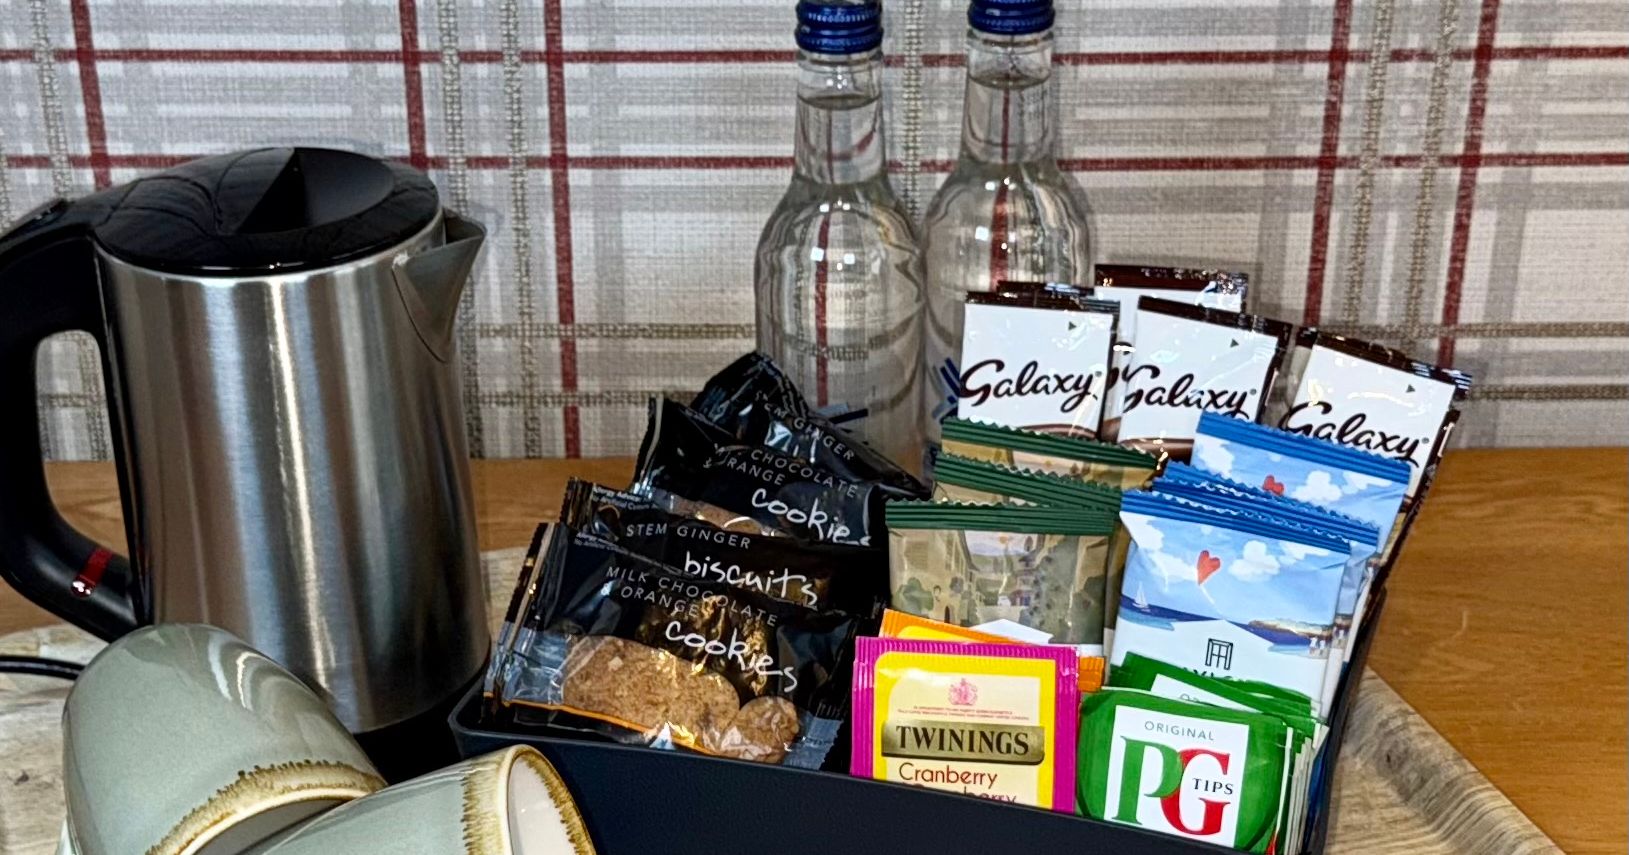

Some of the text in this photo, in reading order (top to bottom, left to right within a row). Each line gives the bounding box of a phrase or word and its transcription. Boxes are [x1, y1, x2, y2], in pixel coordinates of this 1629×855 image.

[959, 359, 1098, 414] Galaxy
[1121, 364, 1249, 419] Galaxy
[1279, 401, 1420, 468] Galaxy
[751, 449, 858, 498] CHOCOLATE
[626, 523, 751, 549] STEM GINGER
[606, 566, 778, 628] MILK CHOCOLATE
[620, 585, 699, 618] ORANGE
[685, 550, 818, 605] biscuits
[665, 620, 798, 693] cookies
[896, 725, 1029, 756] TWININGS
[1144, 720, 1215, 741] ORIGINAL
[899, 761, 998, 789] Cranberry
[1111, 735, 1234, 836] PG TIPS
